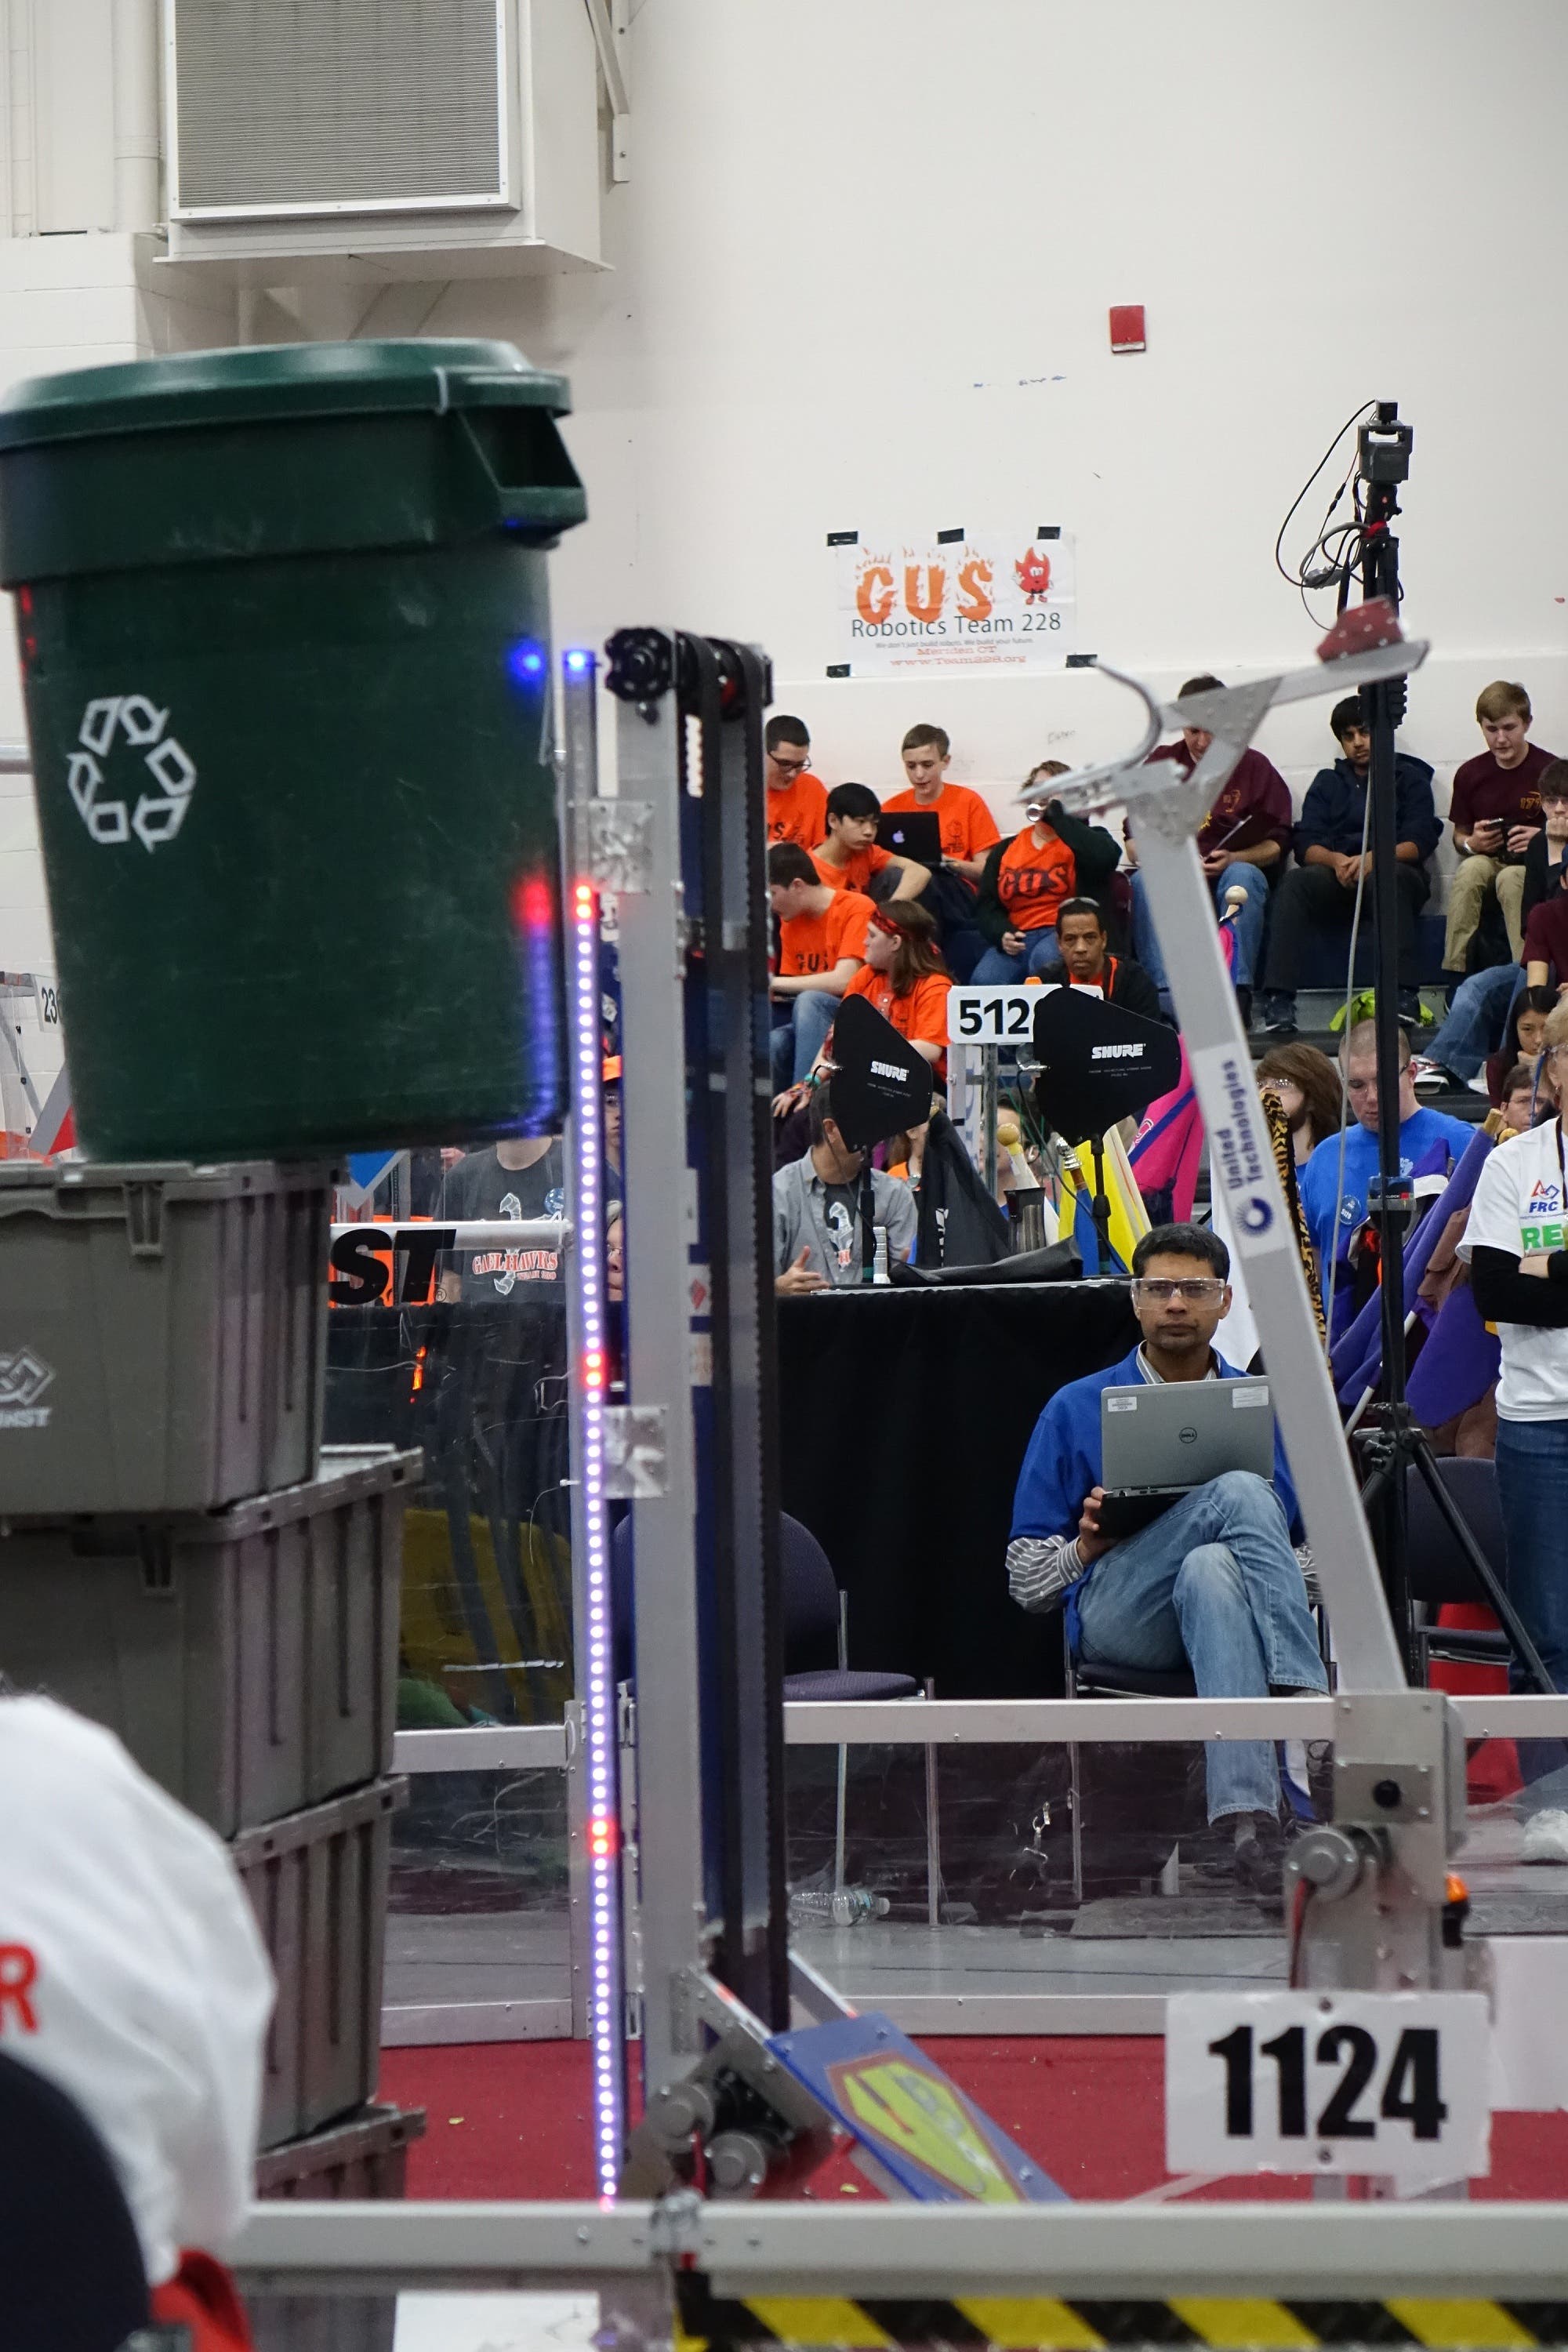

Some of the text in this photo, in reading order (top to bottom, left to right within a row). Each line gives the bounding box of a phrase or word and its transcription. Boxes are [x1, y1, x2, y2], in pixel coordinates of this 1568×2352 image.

[855, 554, 993, 624] GUS
[851, 612, 1062, 637] Robotics Team 228
[916, 645, 997, 655] Meriden CT
[998, 863, 1068, 901] GUS
[1091, 1044, 1145, 1059] SHURE
[870, 1061, 908, 1082] SHURE
[1223, 1061, 1264, 1182] Technologies
[1215, 1129, 1243, 1190] United
[1529, 1200, 1559, 1214] FRC
[1208, 2024, 1449, 2141] 1124
